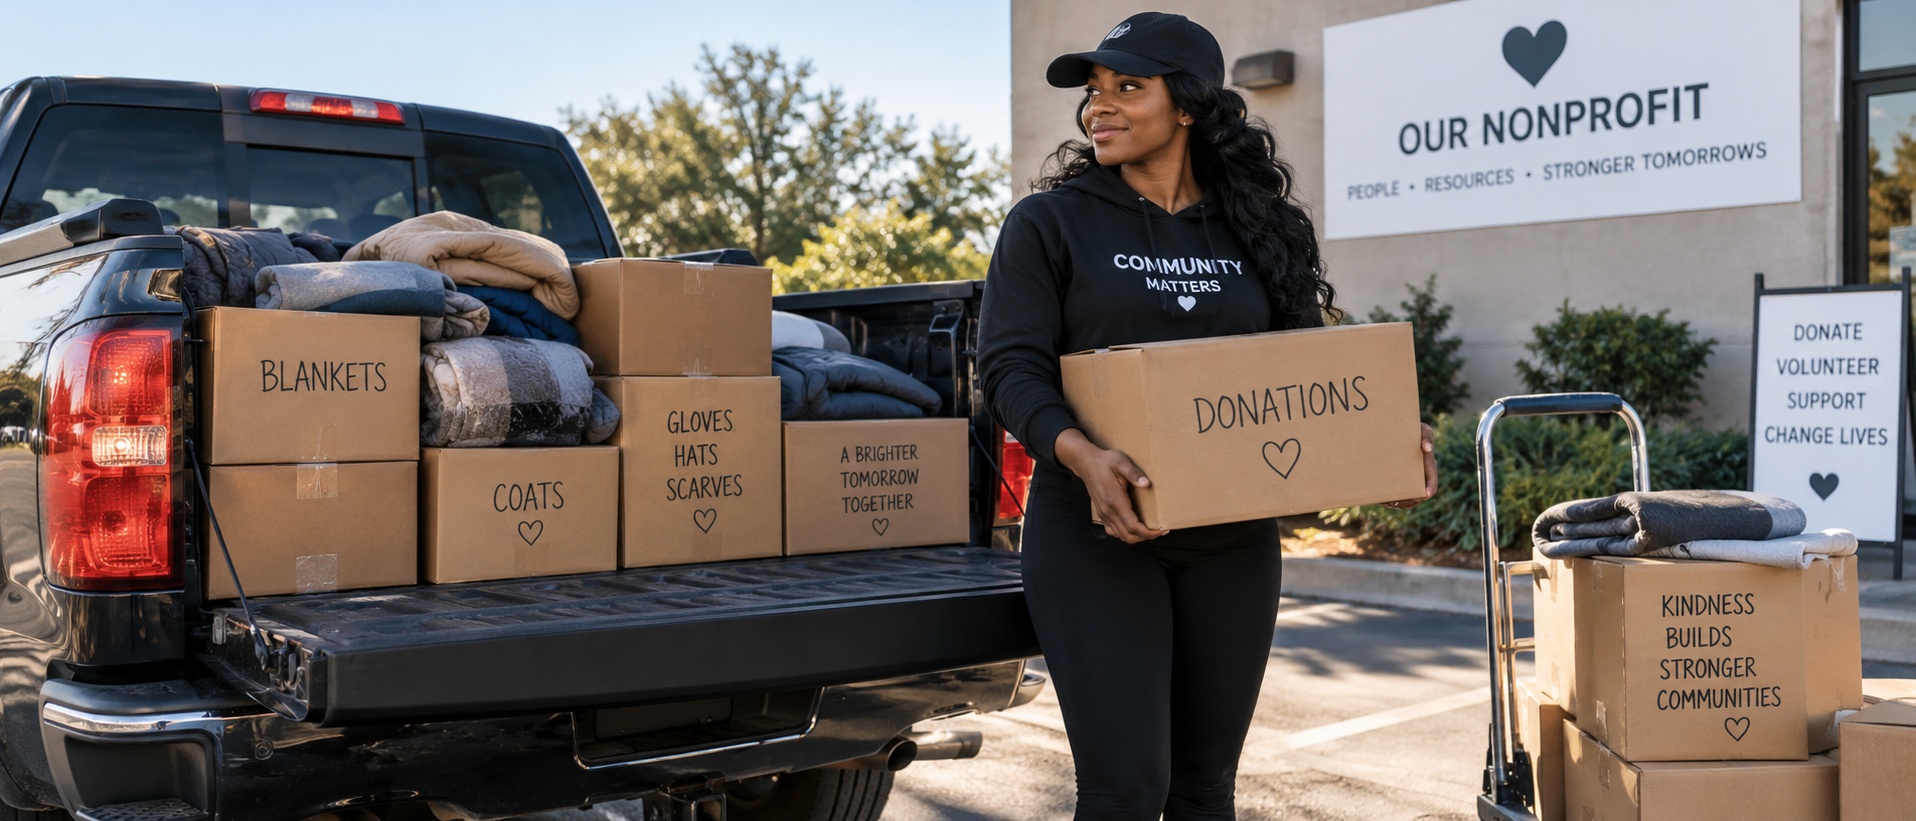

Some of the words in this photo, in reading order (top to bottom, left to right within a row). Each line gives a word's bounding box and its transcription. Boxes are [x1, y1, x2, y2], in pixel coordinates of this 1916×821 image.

[1399, 116, 1468, 156] OUR
[1482, 82, 1709, 145] NONPROFIT
[1347, 180, 1399, 200] PEOPLE
[1425, 168, 1514, 192] RESOURCES
[1544, 156, 1635, 179] STRONGER
[1642, 141, 1767, 169] TOMORROWS
[1113, 253, 1243, 276] COMMUNITY
[1145, 276, 1222, 293] MATTERS
[1794, 323, 1862, 341] DONATE
[260, 359, 387, 393] BLANKETS
[1777, 358, 1879, 375] VOLUNTEER
[1193, 375, 1369, 434] DONATIONS
[1788, 392, 1866, 410] SUPPORT
[667, 409, 733, 434] GLOVES
[1765, 426, 1833, 444] CHANGE
[1840, 427, 1888, 446] LIVES
[674, 443, 718, 468] HATS
[840, 446, 850, 464] A
[855, 444, 918, 463] BRIGHTER
[666, 474, 743, 502] SCARVES
[840, 468, 919, 489] TOMORROW
[493, 480, 565, 513] COATS
[841, 493, 914, 514] TOGETHER
[1662, 592, 1755, 618] KINDNESS
[1665, 625, 1732, 650] BUILDS
[1659, 656, 1757, 680] STRONGER
[1656, 685, 1782, 711] COMMUNITIES
